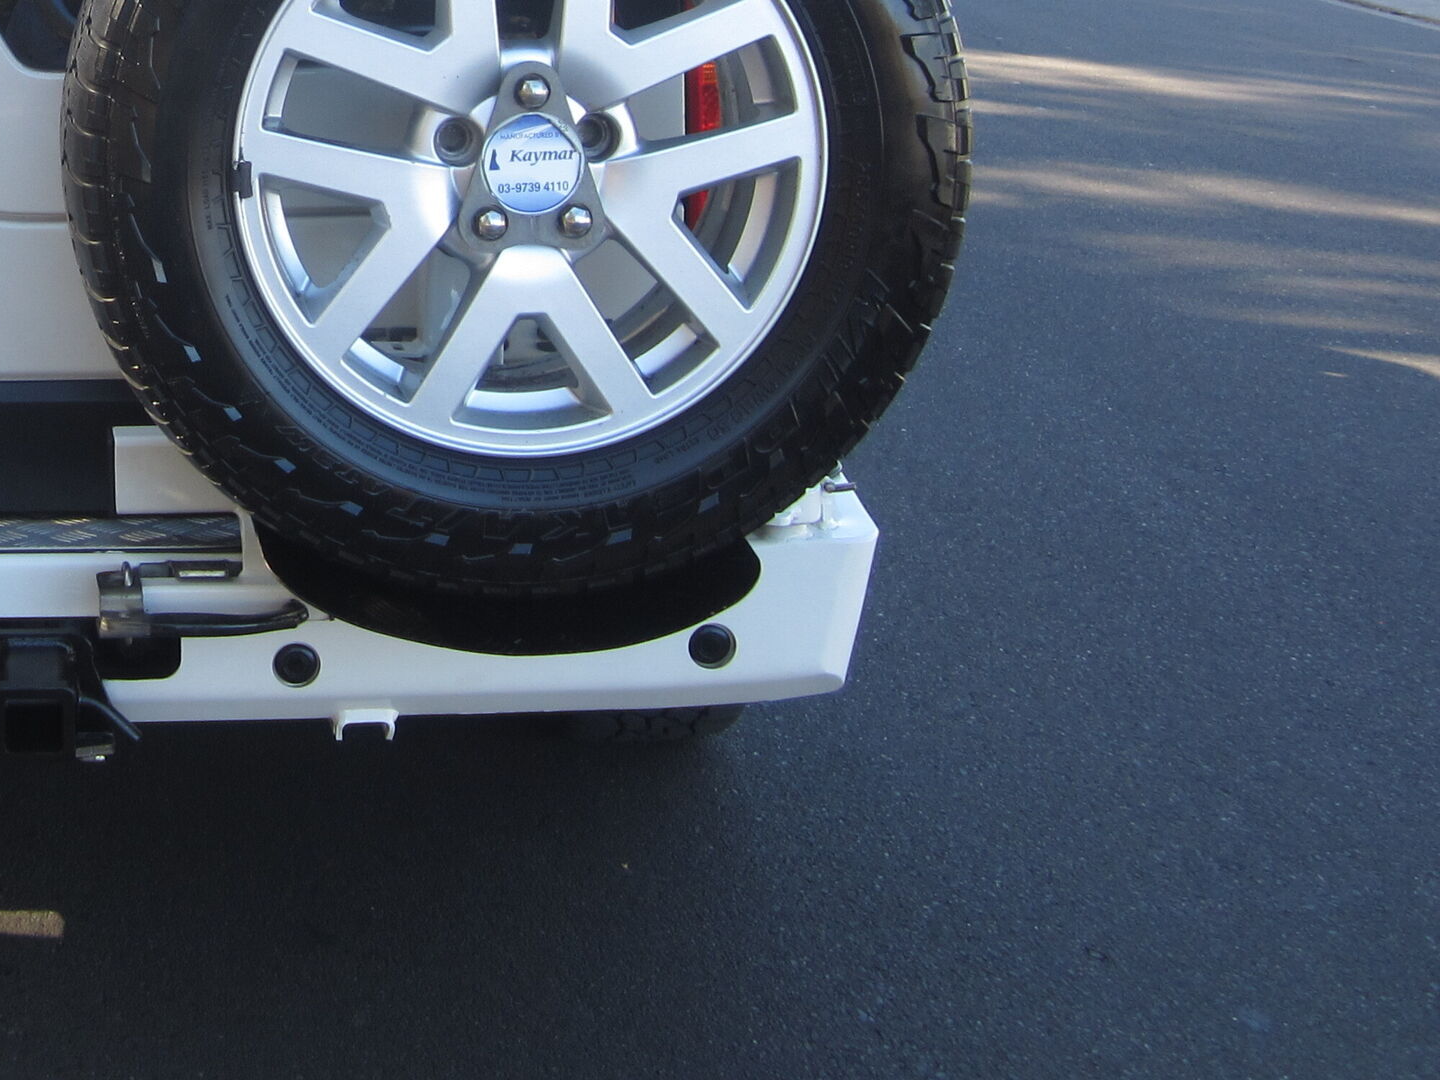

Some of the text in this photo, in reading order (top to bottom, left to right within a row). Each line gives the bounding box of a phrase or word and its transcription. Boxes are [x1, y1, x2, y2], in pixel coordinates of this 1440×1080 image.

[510, 149, 576, 167] Kaymar
[497, 180, 569, 194] 03-9739 4110
